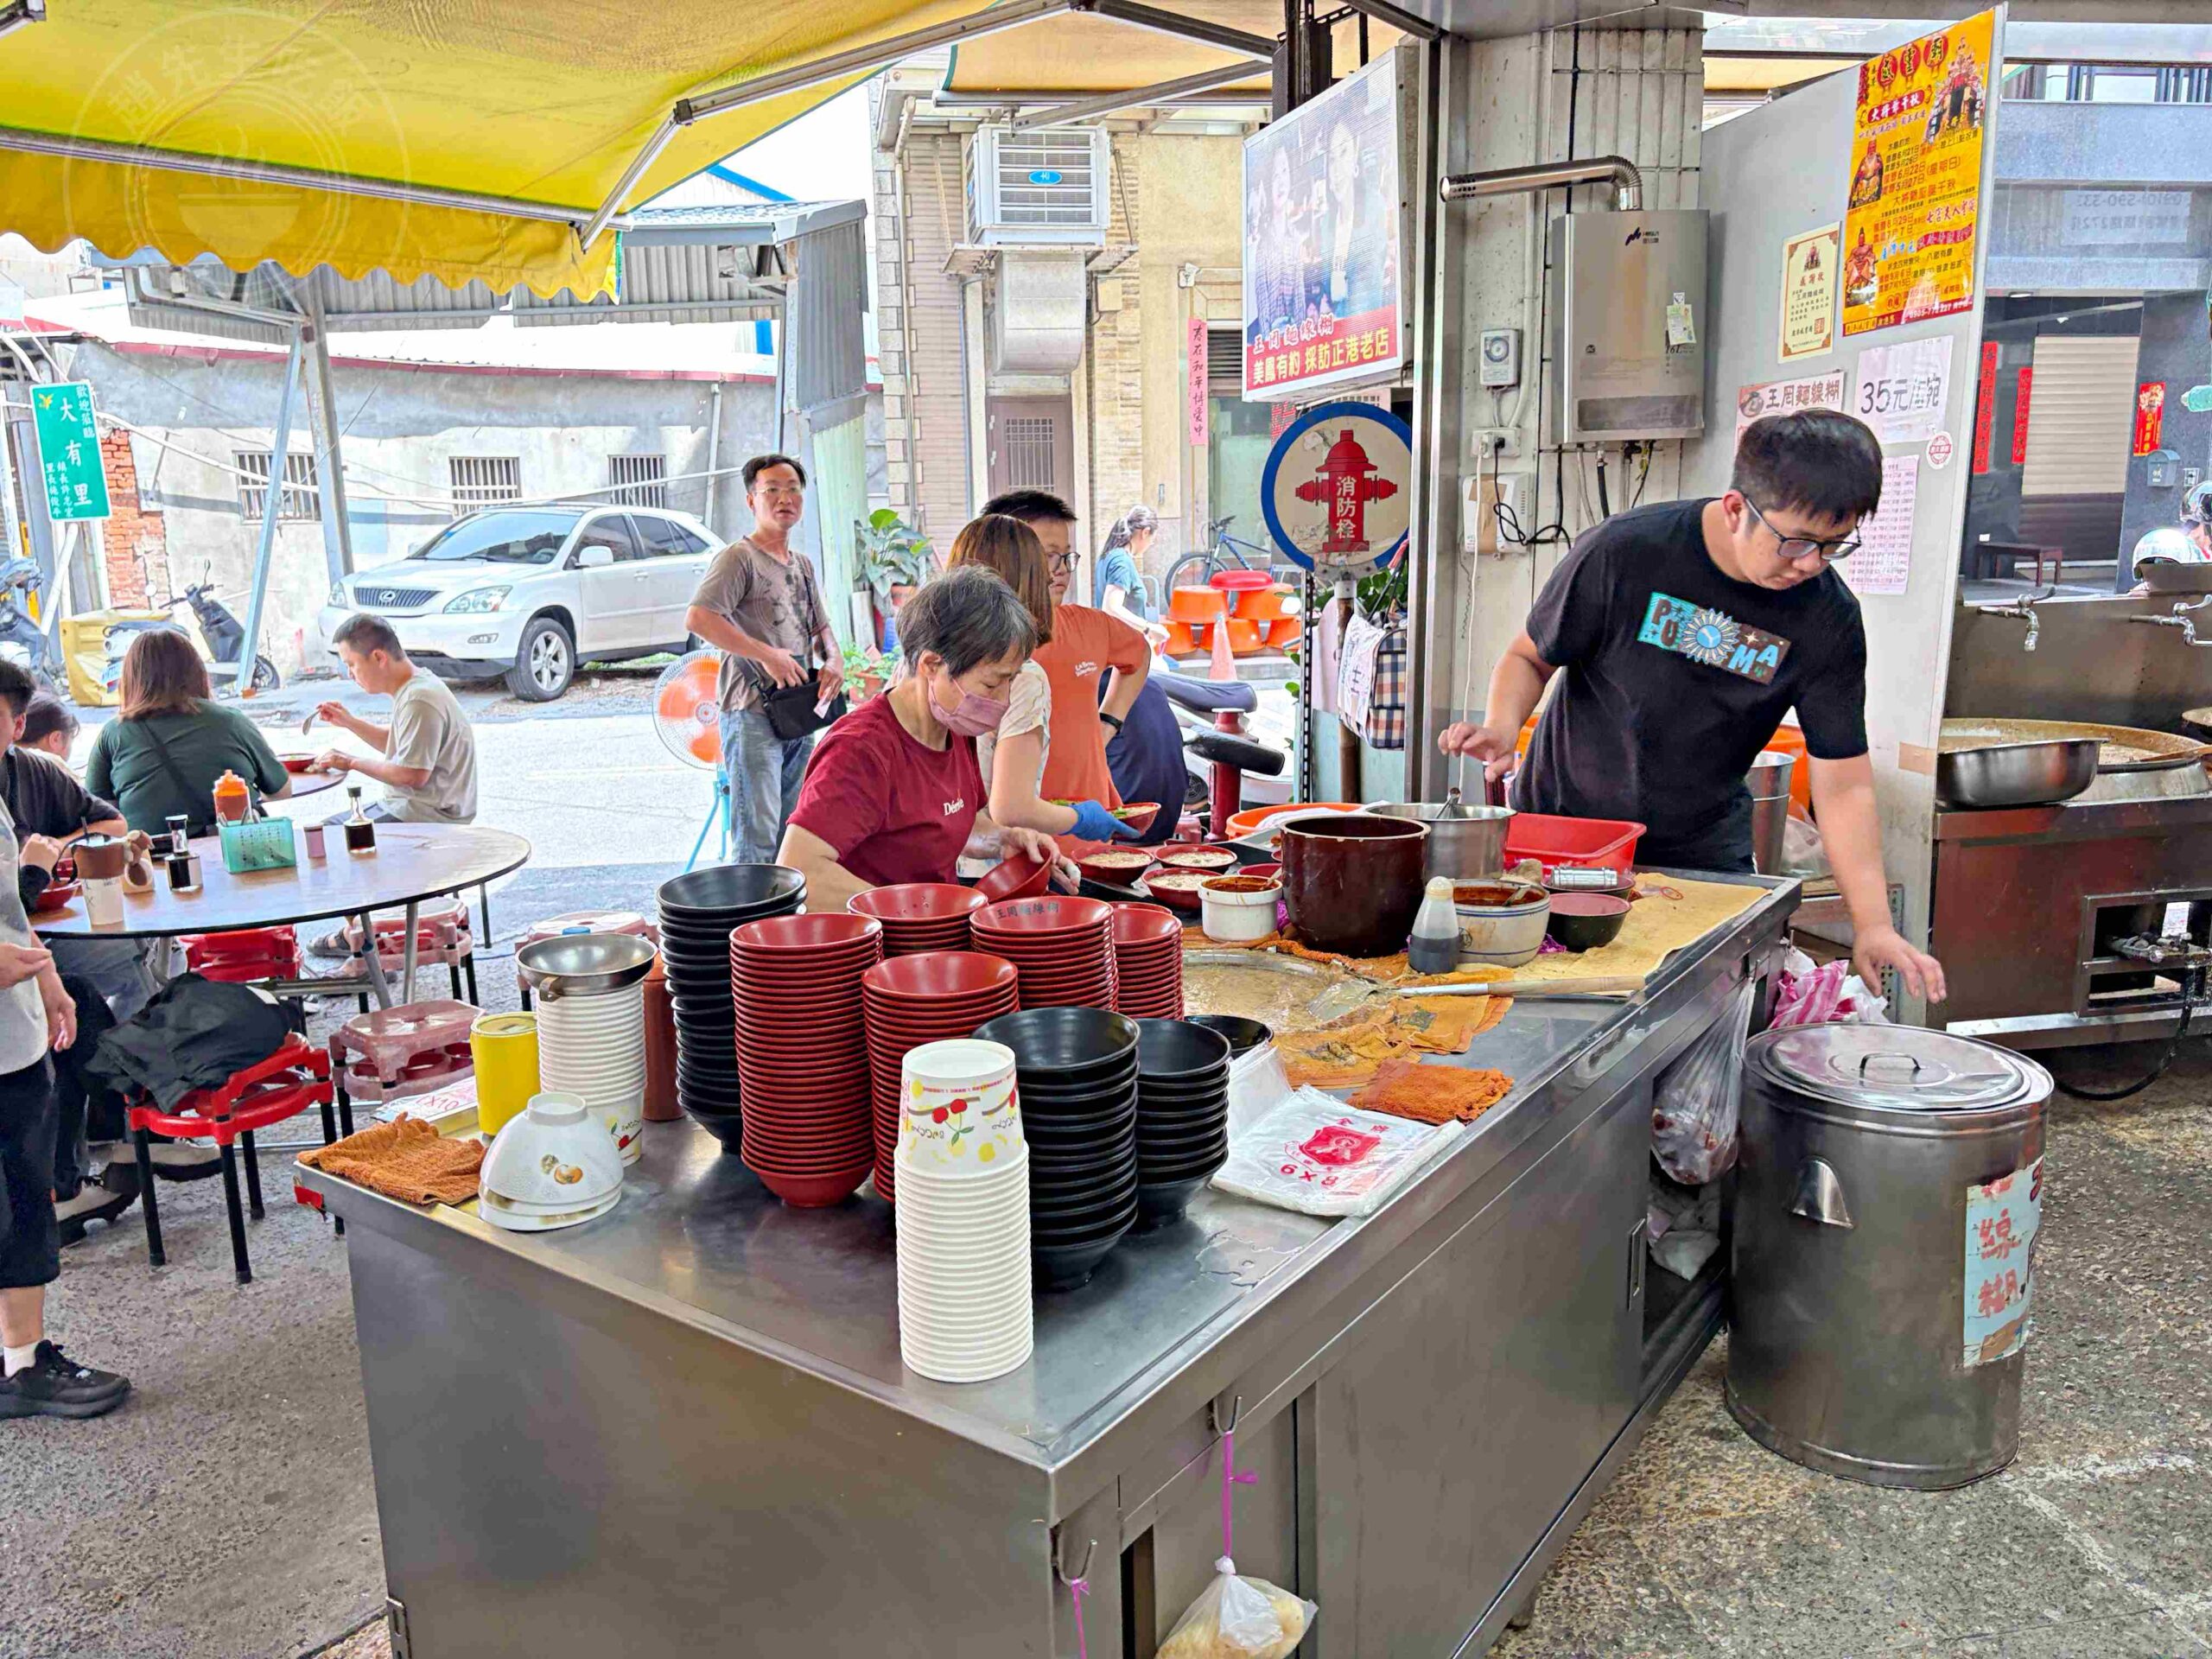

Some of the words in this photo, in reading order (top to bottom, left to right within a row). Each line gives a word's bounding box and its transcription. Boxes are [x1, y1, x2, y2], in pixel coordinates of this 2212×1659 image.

[1304, 327, 1389, 373] 採訪正港老店
[60, 397, 92, 507] 大有里
[1336, 475, 1357, 539] 消防栓
